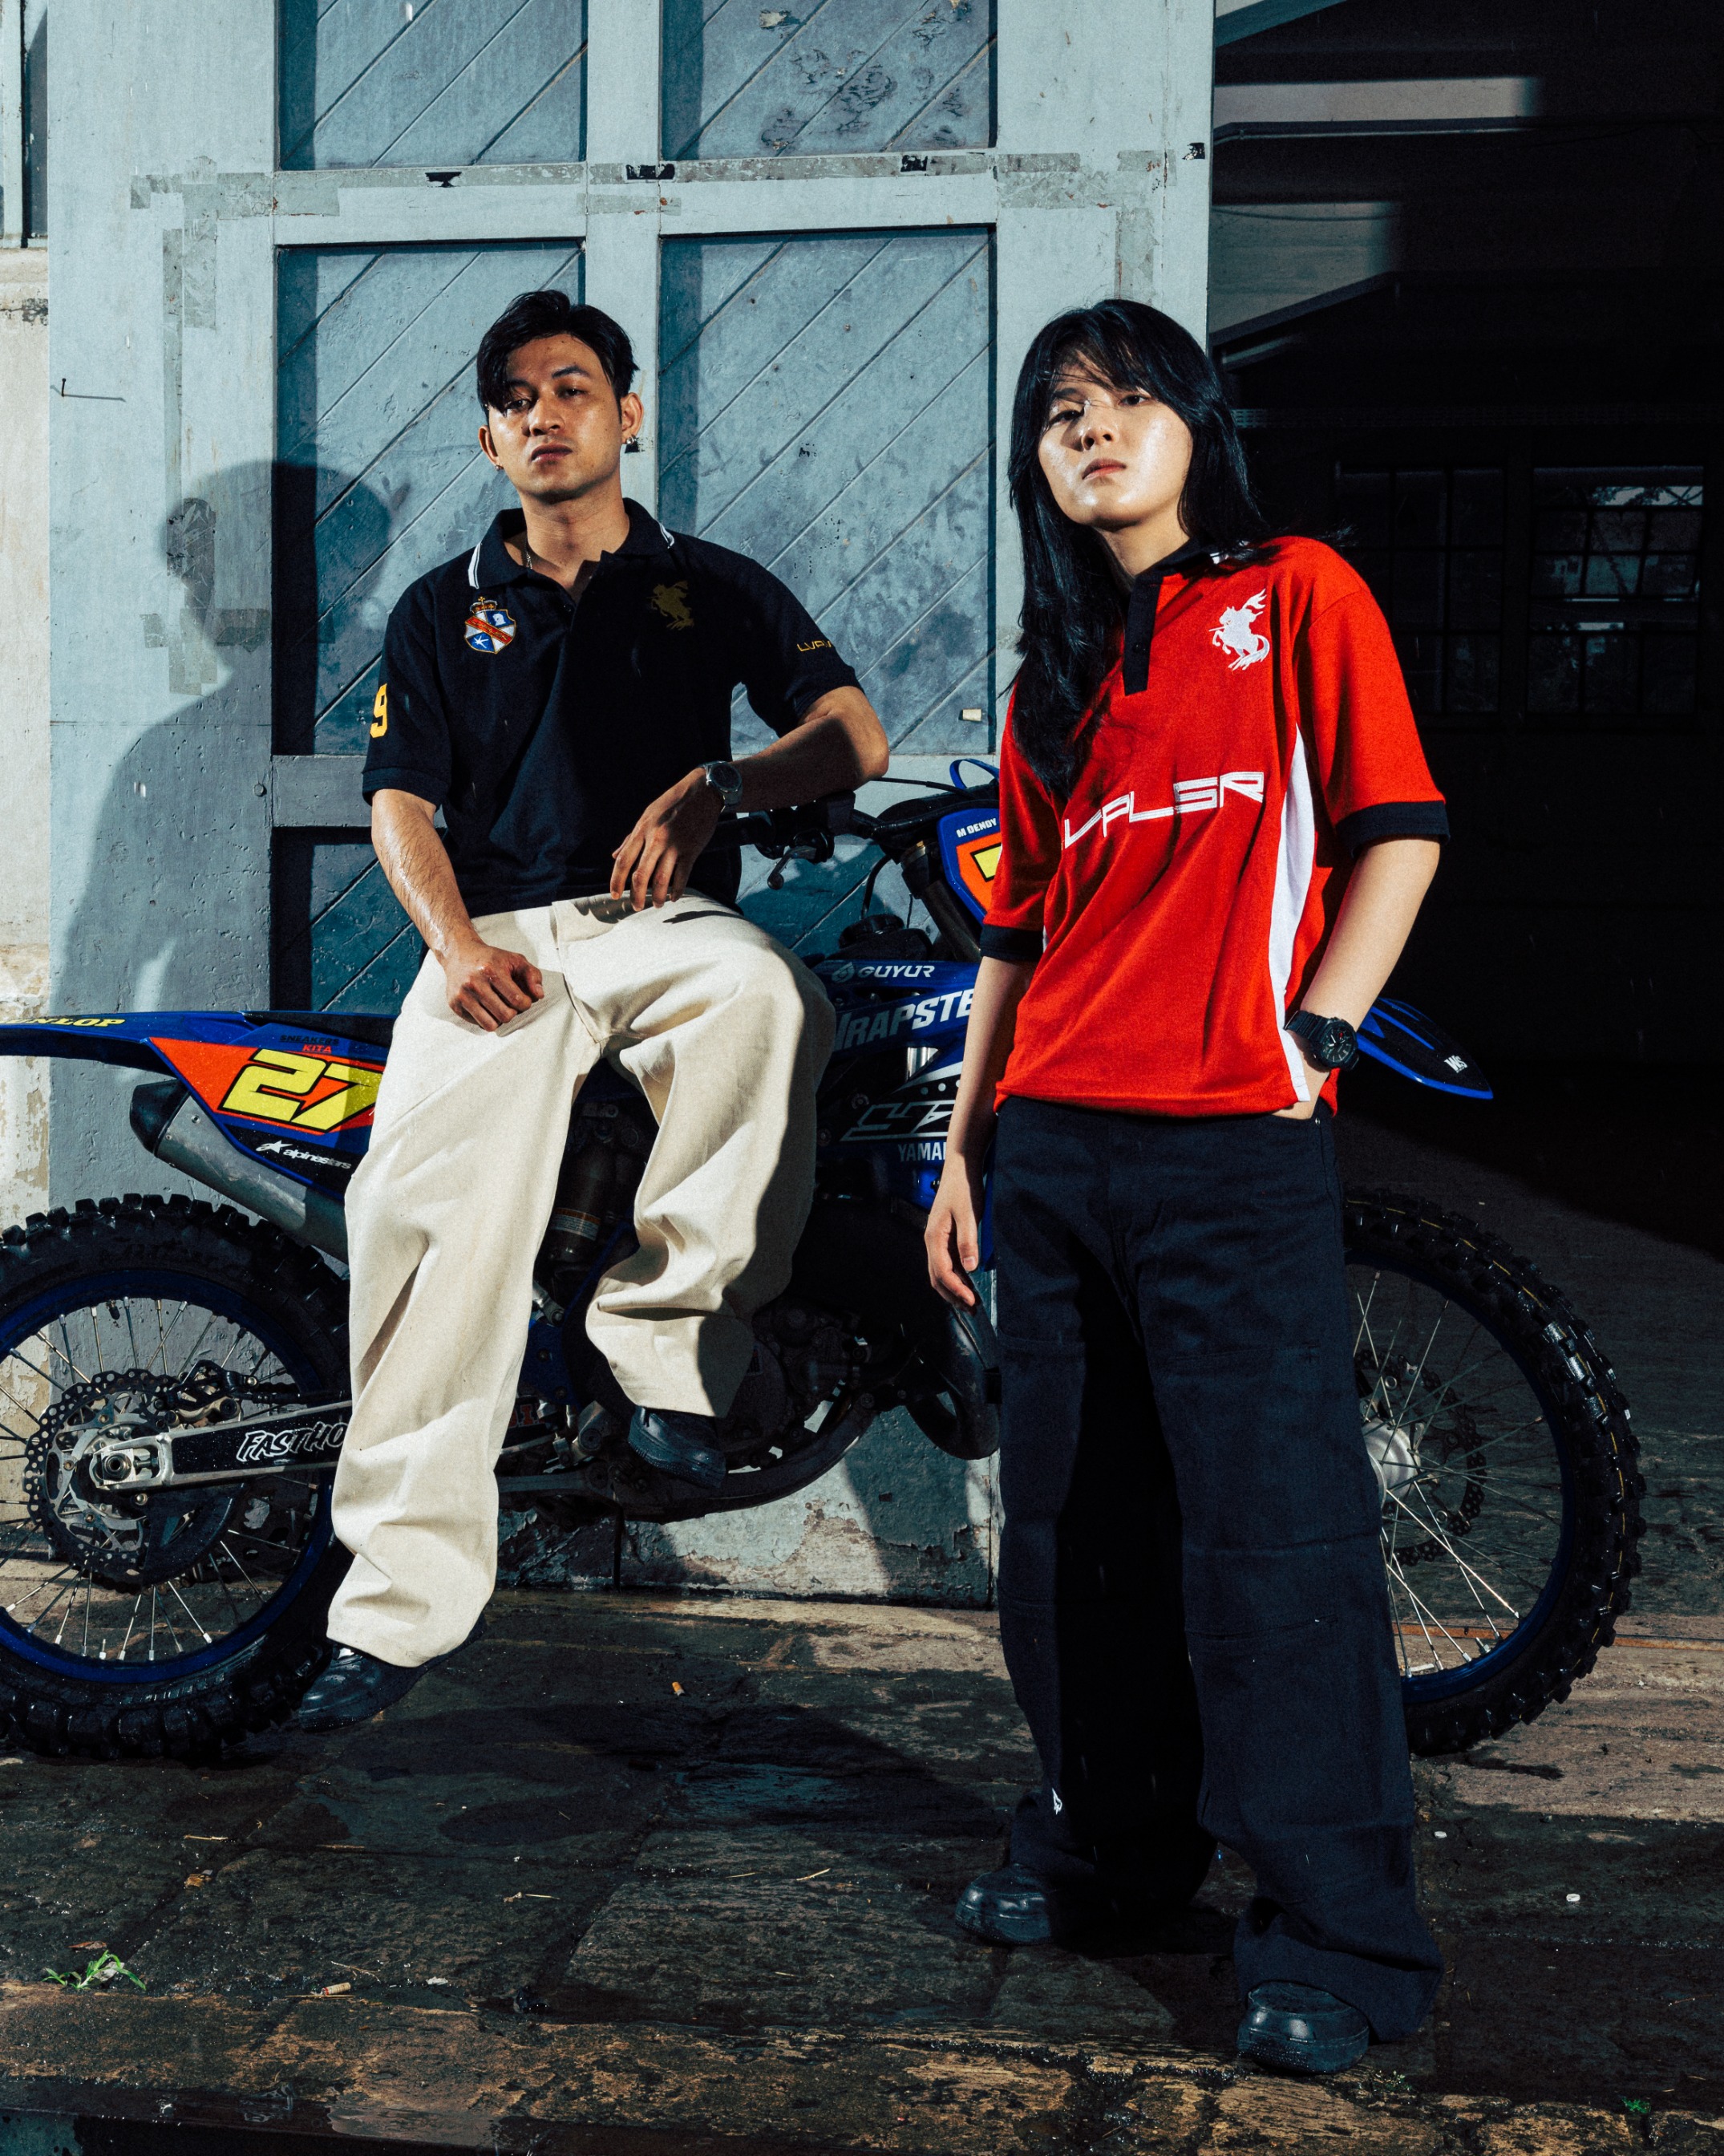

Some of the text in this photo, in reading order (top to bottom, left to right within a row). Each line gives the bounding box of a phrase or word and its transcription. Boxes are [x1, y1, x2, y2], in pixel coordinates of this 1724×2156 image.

[370, 683, 387, 738] 9
[956, 817, 997, 838] M DENDY
[858, 965, 936, 979] GUYUR
[0, 1018, 126, 1027] UNLOP
[301, 1044, 332, 1054] KITA
[217, 1048, 383, 1133] 27
[282, 1149, 352, 1169] alpinestars
